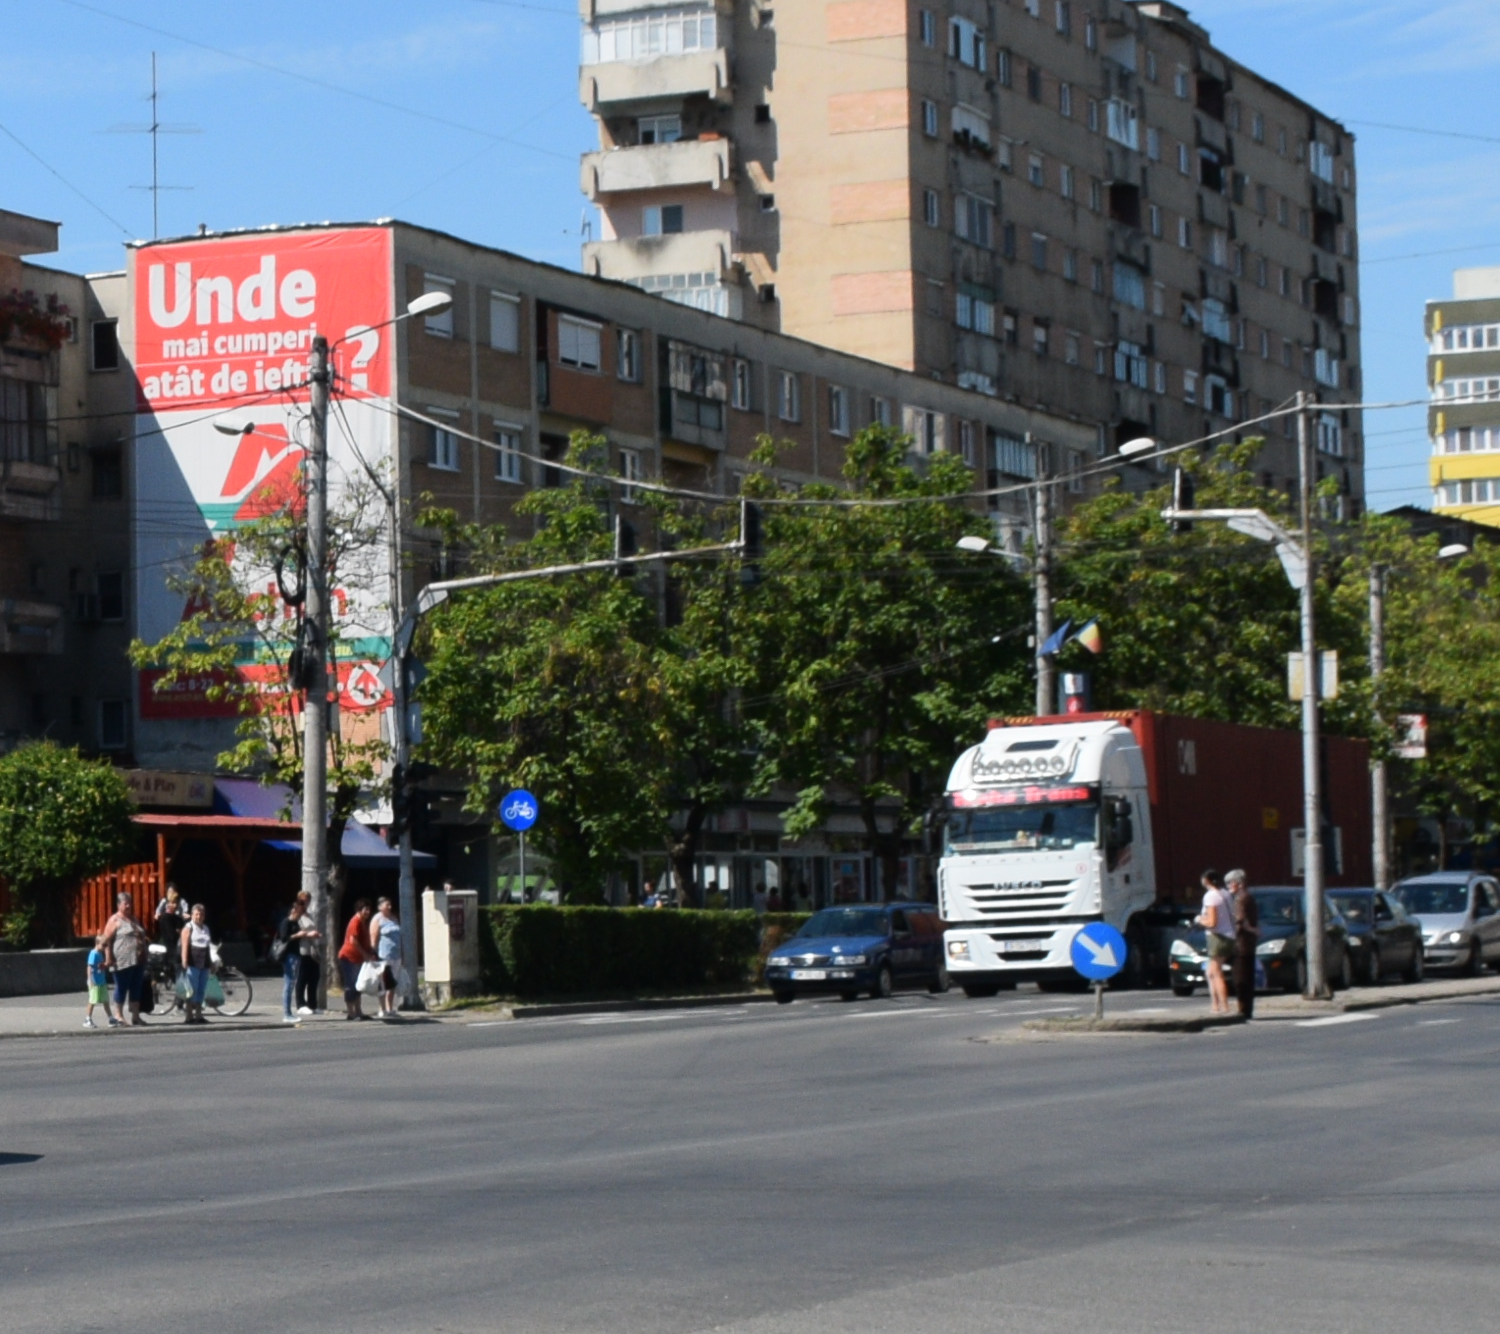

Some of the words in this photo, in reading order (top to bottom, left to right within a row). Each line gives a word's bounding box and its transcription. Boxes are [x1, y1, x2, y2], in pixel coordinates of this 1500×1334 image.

[148, 254, 316, 329] Unde
[162, 331, 208, 358] mai
[143, 365, 205, 399] atât
[210, 363, 248, 394] de
